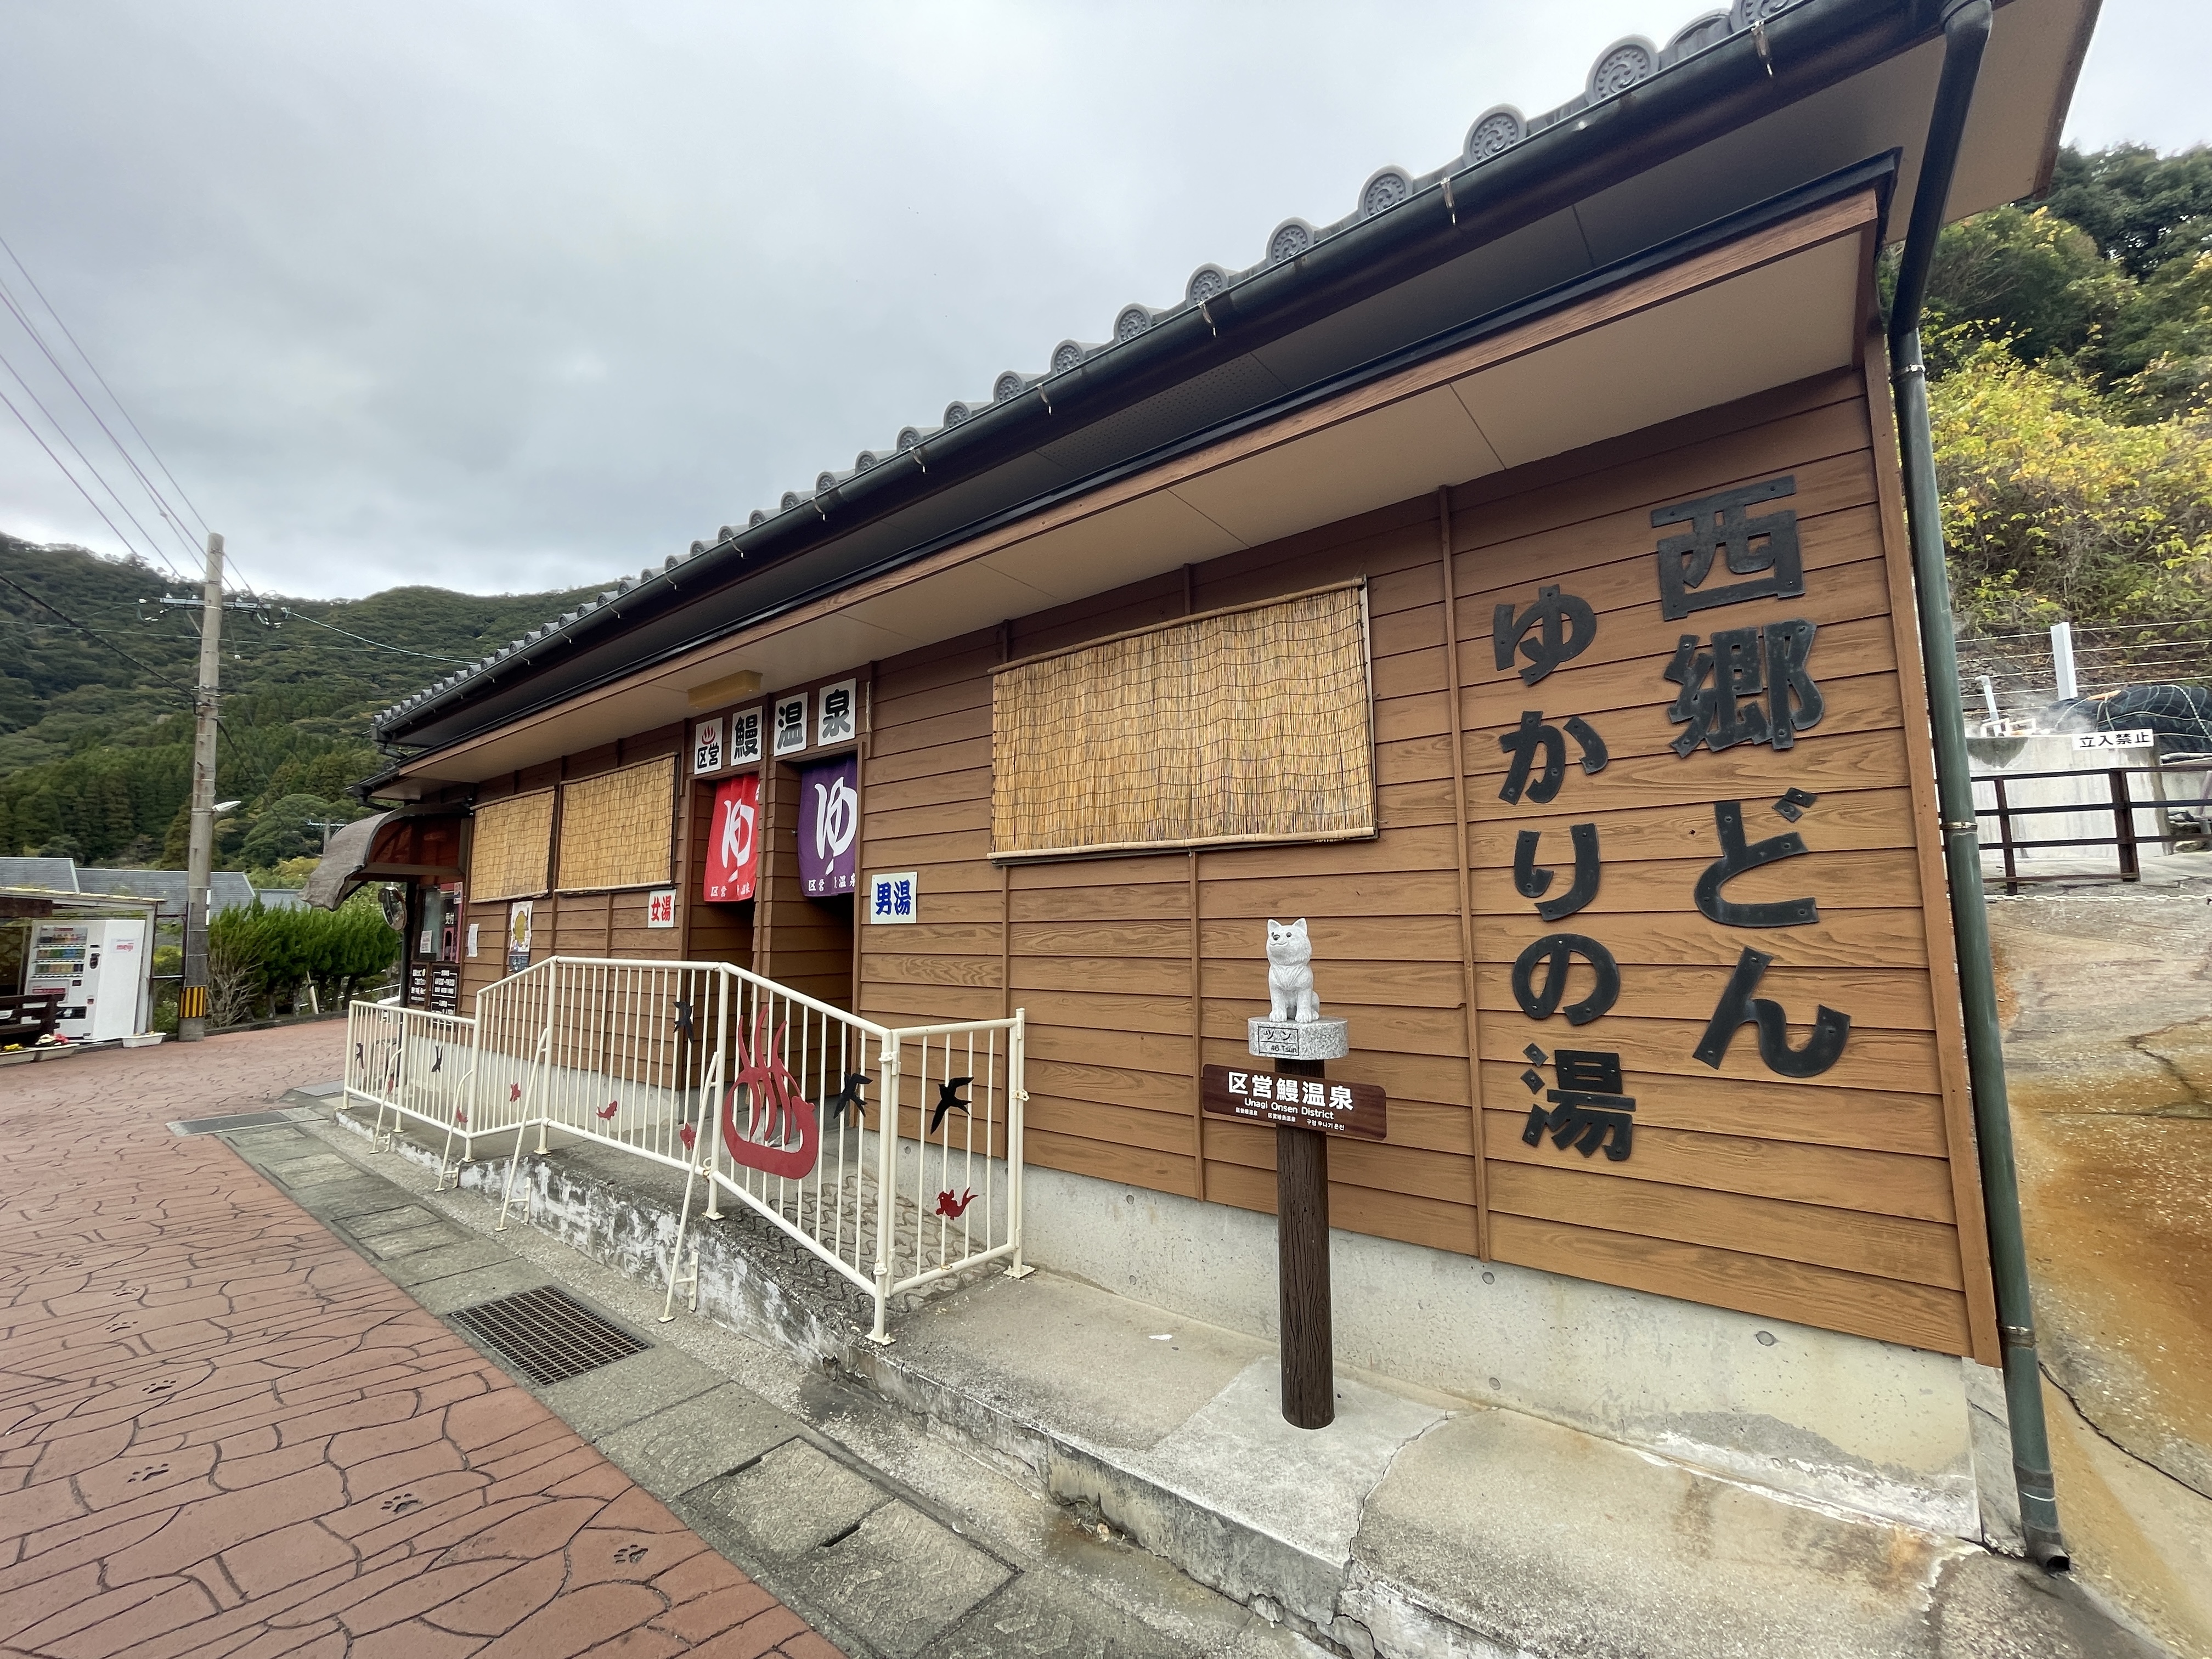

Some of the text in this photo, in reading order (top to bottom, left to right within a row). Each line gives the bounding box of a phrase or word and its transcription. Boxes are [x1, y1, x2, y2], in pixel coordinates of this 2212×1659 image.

[2079, 732, 2151, 748] 立入禁止
[1651, 475, 1850, 1077] 西郷どん
[721, 798, 755, 883] ゆ
[814, 777, 857, 876] ゆ
[1493, 584, 1636, 1162] ゆかりの湯
[651, 895, 672, 922] 女湯
[876, 879, 911, 916] 男湯
[1263, 1030, 1291, 1041] ツン
[1281, 1045, 1297, 1053] Tsun
[1228, 1071, 1354, 1110] 区営鰻温泉
[1244, 1098, 1334, 1120] Unagi Onsen District
